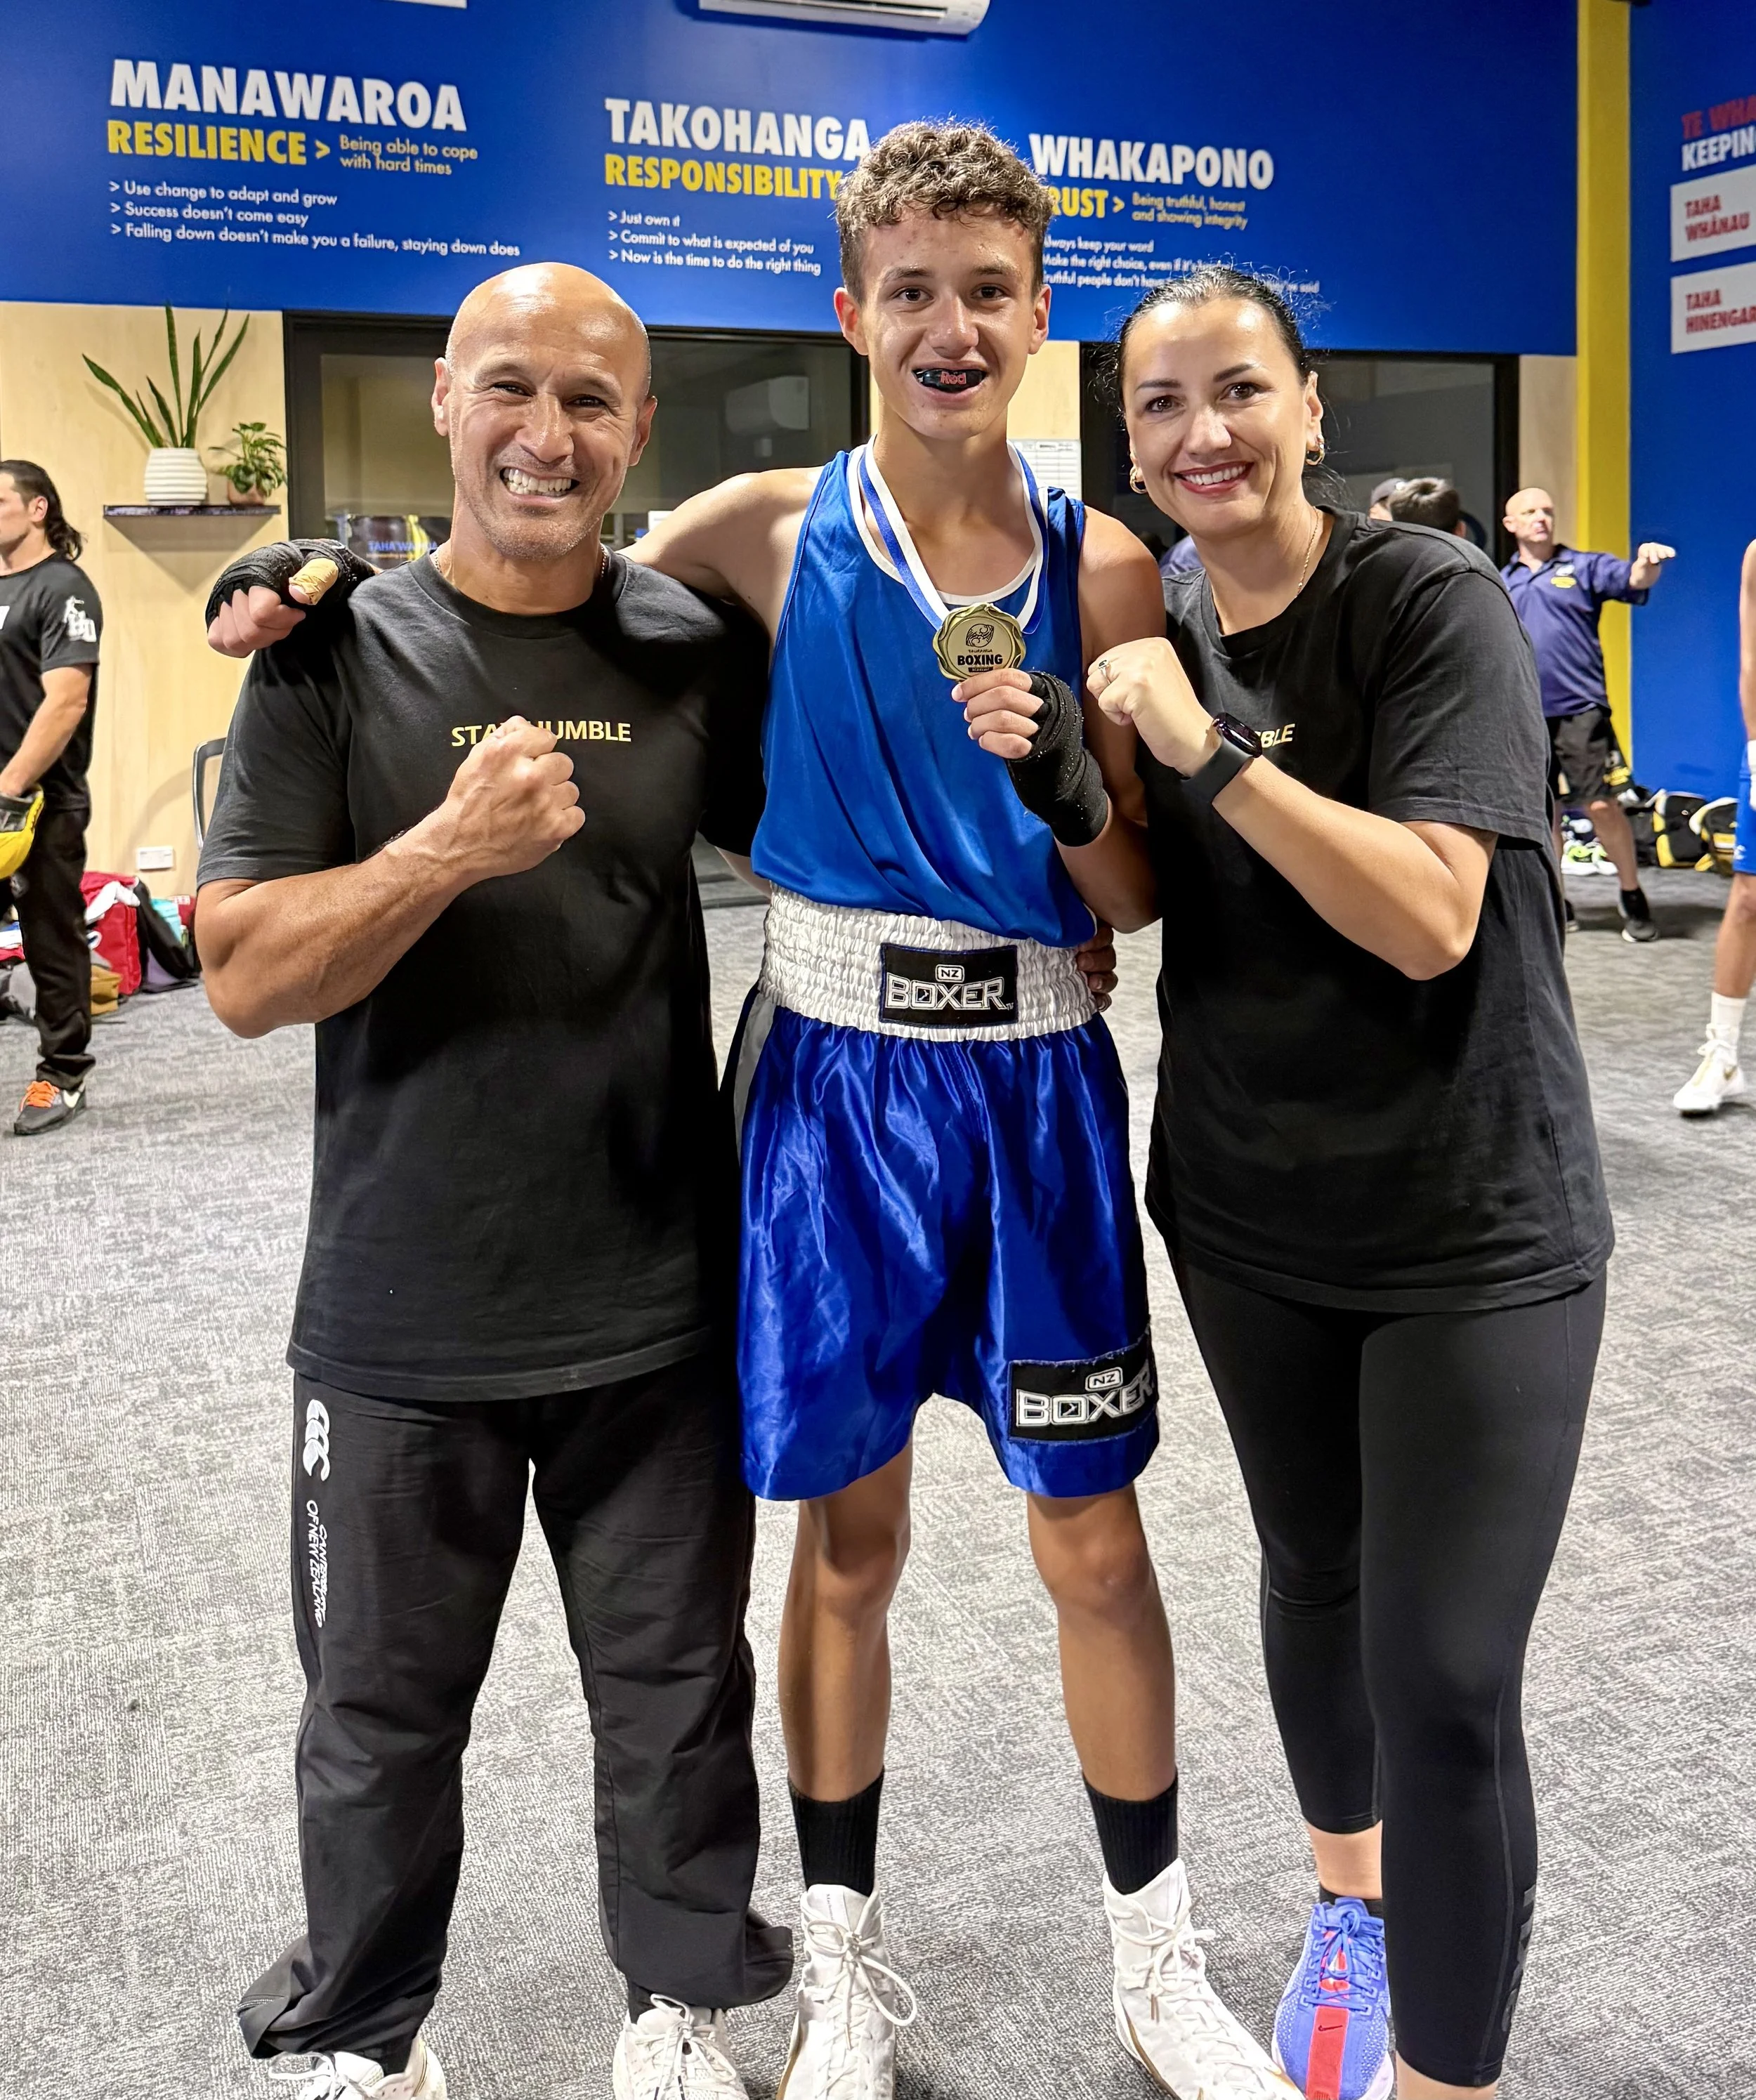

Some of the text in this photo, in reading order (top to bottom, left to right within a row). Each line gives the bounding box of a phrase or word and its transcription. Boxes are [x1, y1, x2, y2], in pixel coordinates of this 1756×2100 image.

[111, 59, 466, 131] MANAWAROA
[605, 98, 871, 161] TAKOHANGA
[1682, 110, 1703, 139] TE
[107, 120, 307, 165] RESILIENCE
[339, 134, 478, 162] Being able to cope
[1682, 126, 1756, 171] KEEPIN
[340, 154, 452, 175] with hard times
[1029, 133, 1274, 190] WHAKAPONO
[605, 154, 842, 199] RESPONSIBILITY
[124, 181, 337, 208] Use change to adapt and grow
[1048, 185, 1108, 218] RUST
[1132, 192, 1164, 209] Being
[1210, 197, 1245, 212] honest
[1685, 194, 1722, 219] TAHA
[125, 201, 308, 228] Success doesn't come easy
[620, 210, 680, 227] Just own it
[1132, 209, 1248, 230] and showing integrity
[126, 223, 520, 256] Falling down doesn't make you a failure, staying down does
[620, 229, 814, 257] Commit to what is expected of you
[1077, 236, 1102, 254] keep
[1103, 241, 1126, 254] your
[1128, 239, 1154, 253] word
[621, 249, 821, 276] Now is the time to do the right thing
[1070, 254, 1087, 268] the
[1088, 255, 1111, 271] right
[1148, 261, 1172, 271] even
[1077, 272, 1113, 289] people
[1686, 289, 1722, 312] TAHA
[957, 654, 1003, 665] BOXING
[452, 723, 504, 747] STA
[941, 969, 959, 978] NZ
[885, 972, 1007, 1010] BOXER
[1016, 1359, 1153, 1426] BOXER
[1093, 1373, 1115, 1386] NZ
[306, 1499, 319, 1525] OF
[308, 1522, 320, 1561] NEW
